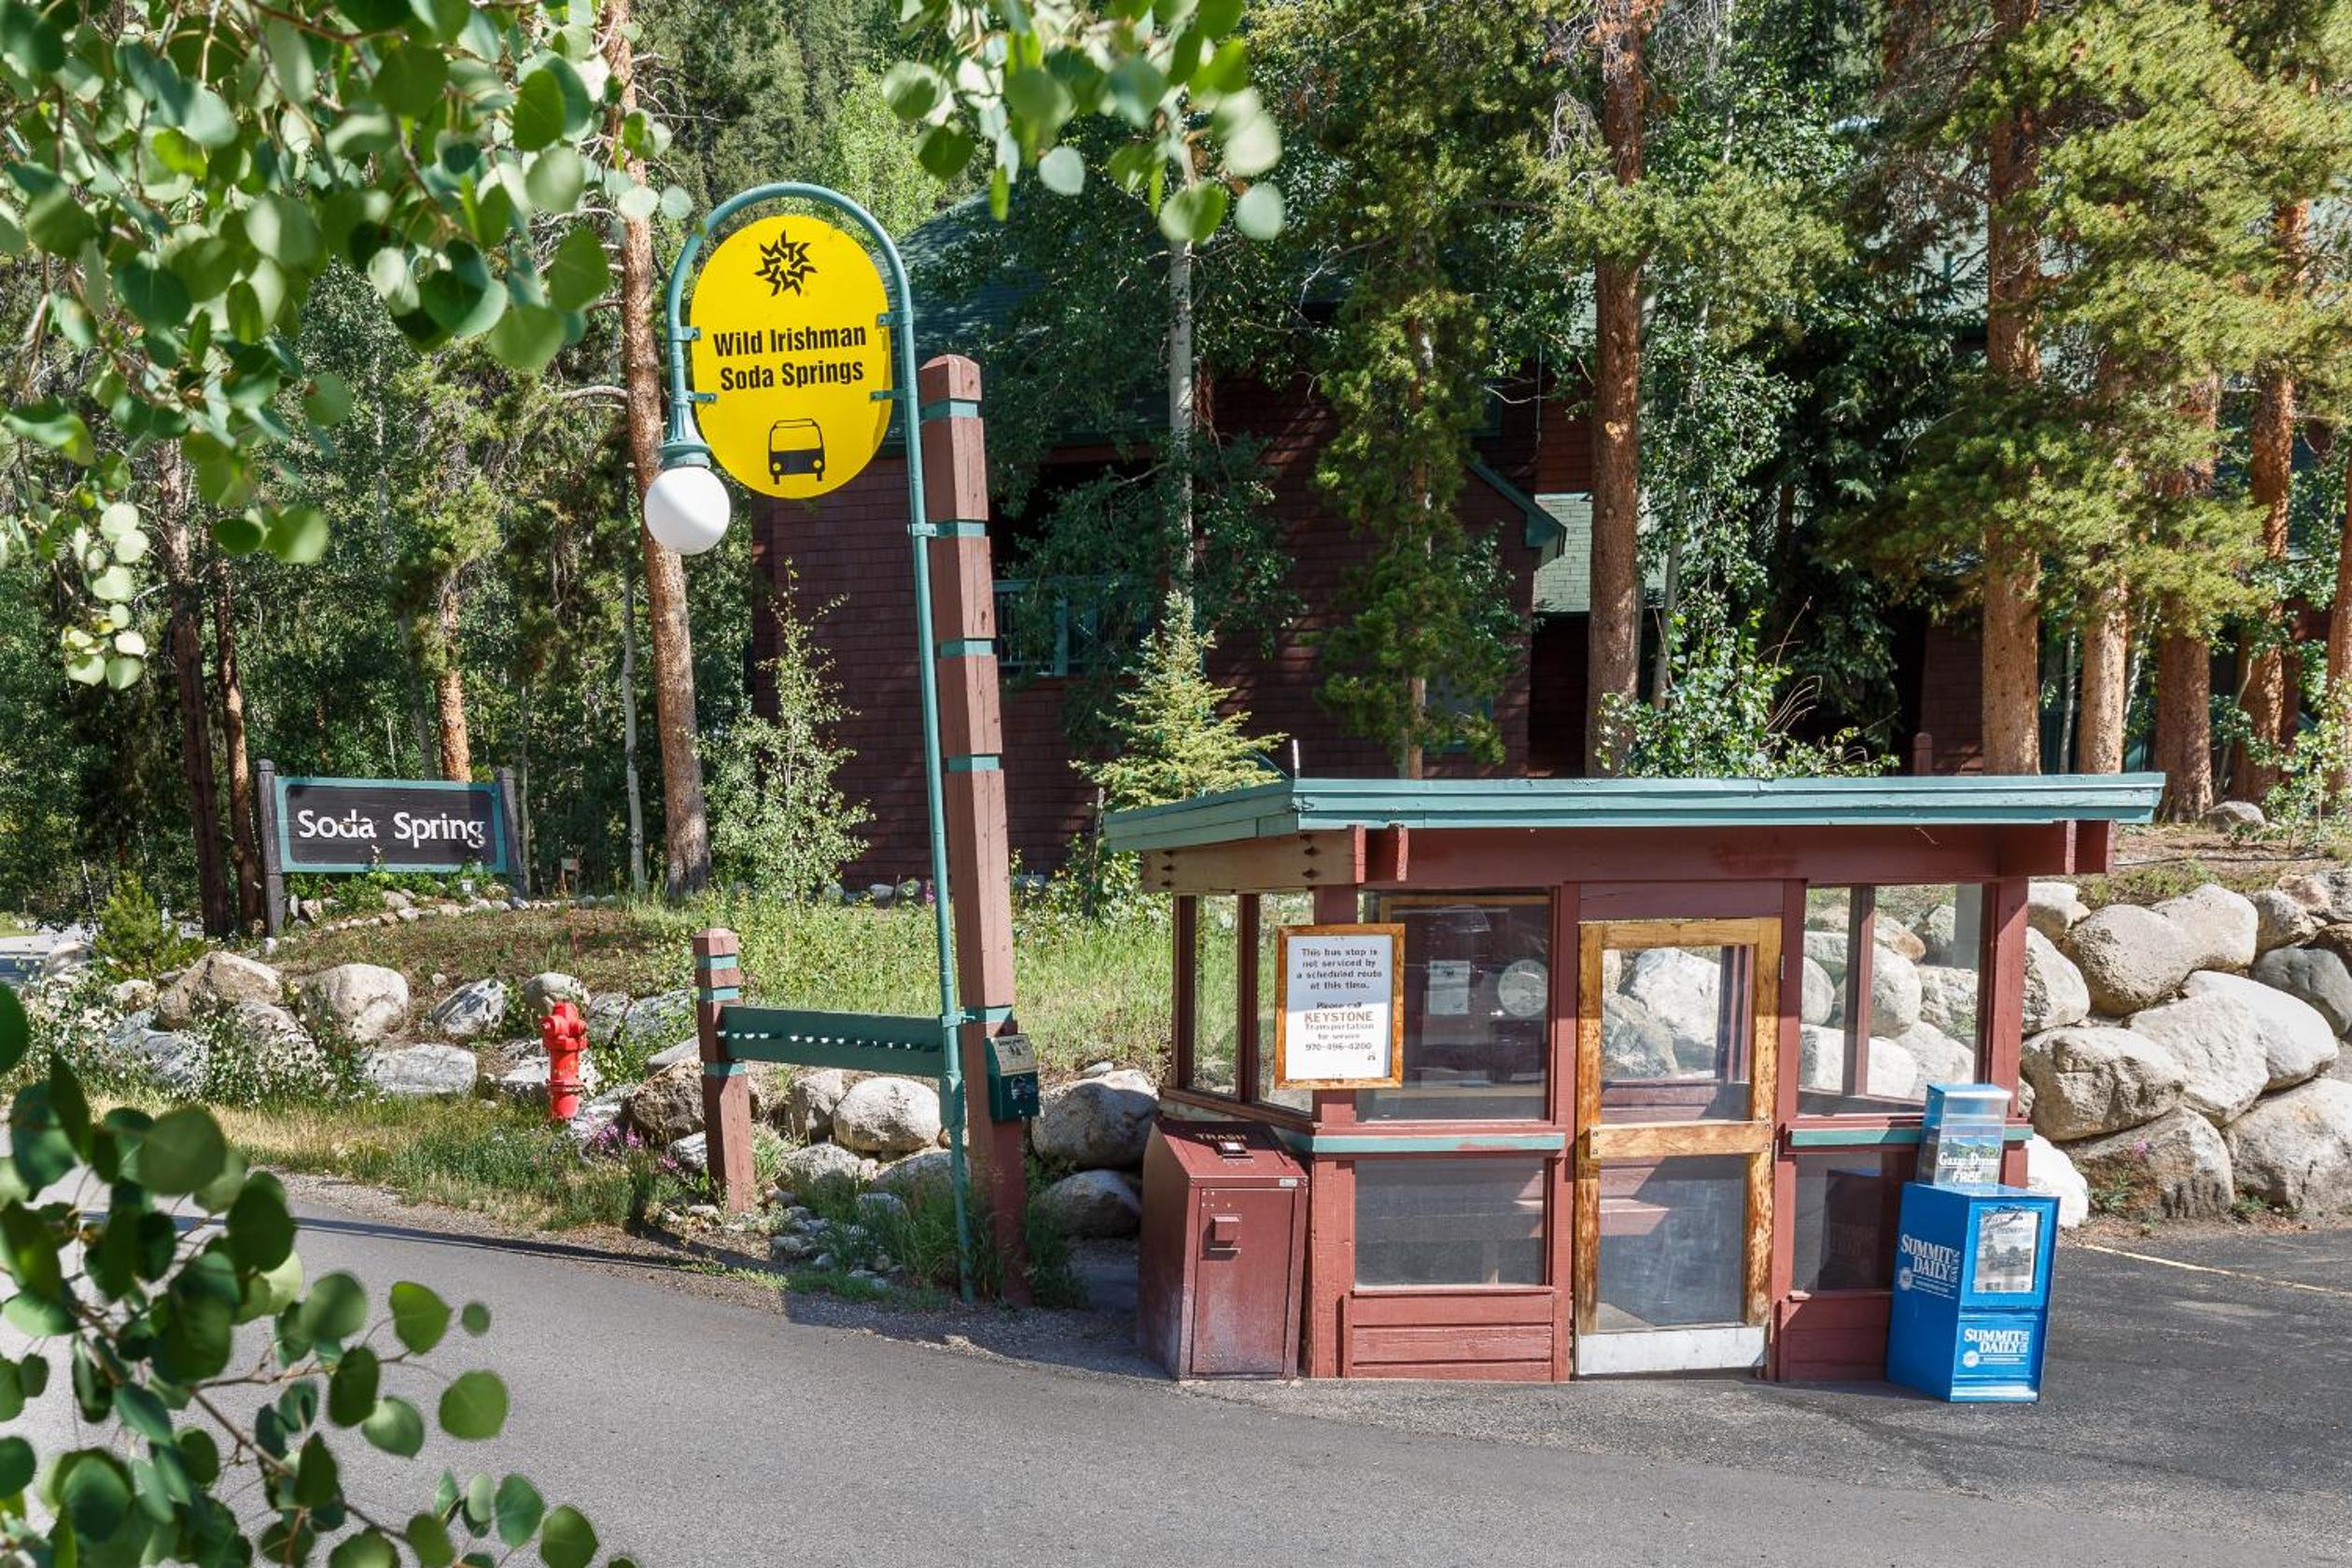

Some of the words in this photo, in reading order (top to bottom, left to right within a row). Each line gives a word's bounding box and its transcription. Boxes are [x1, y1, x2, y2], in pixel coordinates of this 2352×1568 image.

[713, 329, 763, 357] Wild
[770, 326, 867, 353] Irishman
[721, 365, 775, 391] Soda
[782, 360, 864, 388] Springs
[297, 809, 377, 838] Soda
[393, 812, 485, 848] Spring
[1300, 947, 1321, 957] This
[1324, 947, 1341, 956] bus
[1345, 947, 1366, 957] stop
[1369, 947, 1378, 956] is
[1302, 959, 1318, 968] not
[1322, 959, 1362, 968] serviced
[1365, 959, 1377, 968] by
[1306, 971, 1353, 979] scheduled
[1323, 981, 1341, 989] this
[1304, 1011, 1374, 1023] KEYSTONE
[1900, 1234, 1953, 1265] SUMMIT
[1912, 1255, 1951, 1281] DAILY
[1964, 1327, 2022, 1343] SUMMIT
[1980, 1341, 2019, 1353] DAILY
